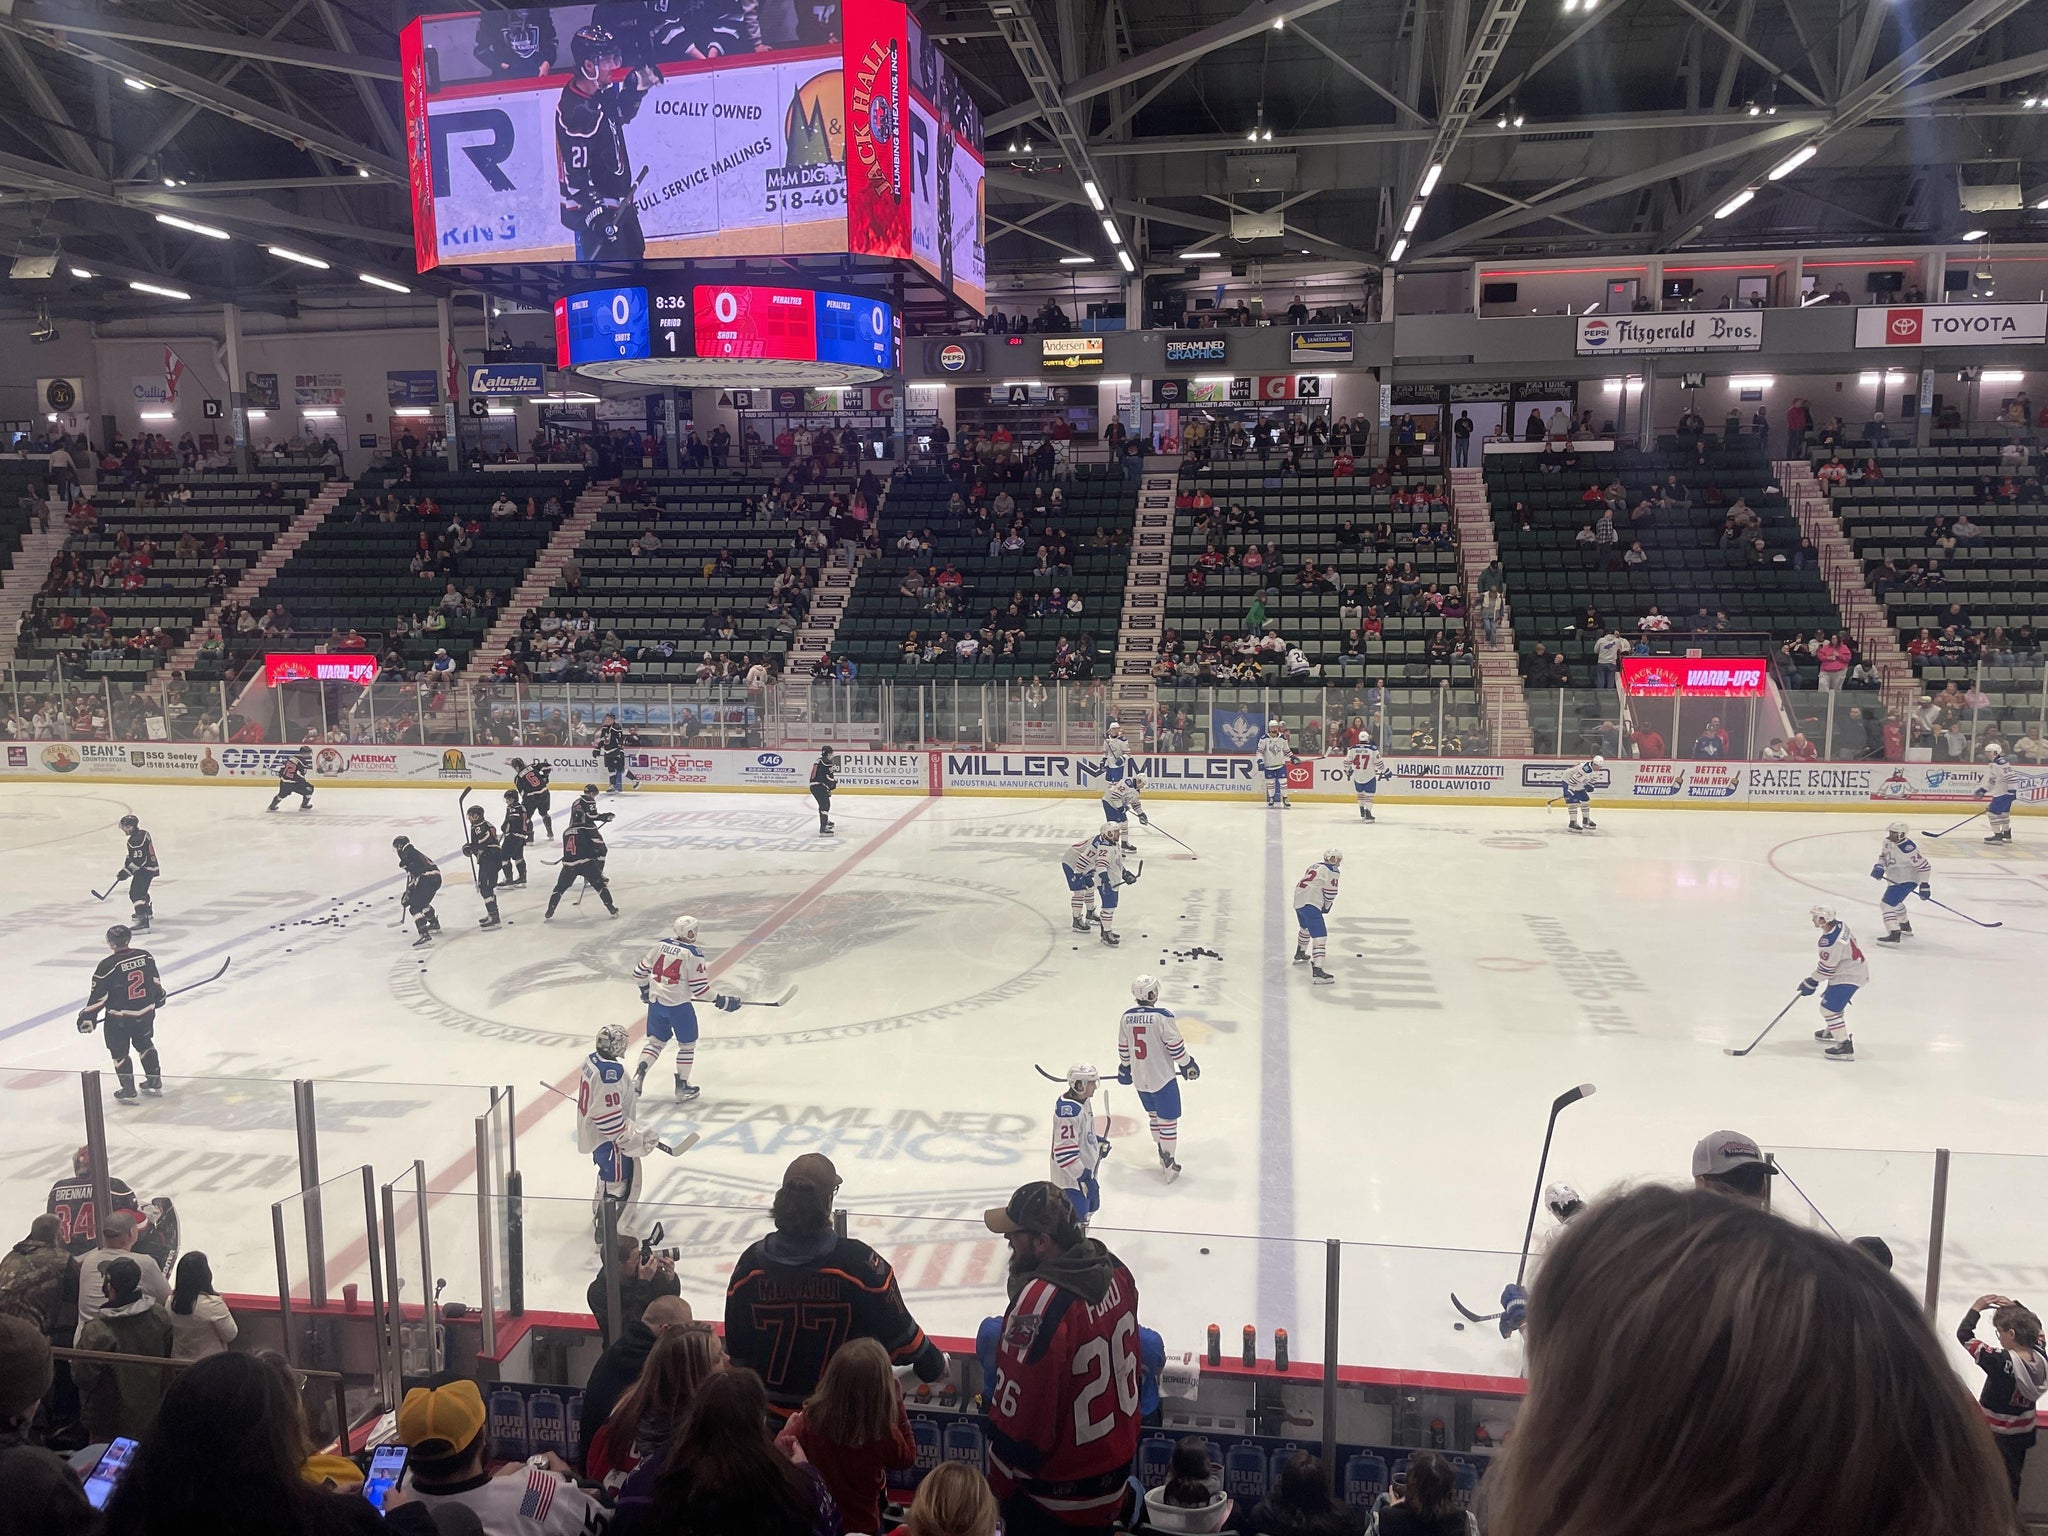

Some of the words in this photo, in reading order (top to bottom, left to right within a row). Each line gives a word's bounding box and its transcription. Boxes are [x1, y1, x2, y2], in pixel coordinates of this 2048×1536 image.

[890, 49, 898, 74] INC.
[852, 40, 892, 113] HALL
[891, 76, 900, 129] HEATING,
[655, 100, 709, 117] LOCALLY
[712, 103, 762, 120] OWNED
[828, 118, 842, 135] &
[892, 129, 900, 141] &
[427, 109, 518, 198] R
[571, 146, 588, 169] 21
[852, 123, 894, 198] JACK
[892, 140, 901, 195] PLUMBING
[632, 192, 661, 214] FULL
[662, 167, 710, 200] SERVICE
[711, 137, 772, 177] MAILINGS
[655, 296, 686, 309] 8:36
[772, 295, 803, 305] PENALTIES
[826, 300, 851, 311] PENALTIES
[612, 295, 630, 325] 0
[715, 292, 737, 323] 0
[659, 318, 682, 327] PERIOD
[871, 306, 884, 335] 0
[1931, 316, 2017, 333] TOYOTA
[614, 333, 631, 342] SHOTS
[717, 331, 737, 340] SHOTS
[1615, 318, 1696, 345] Fitzgerald
[1708, 317, 1757, 340] Bros.
[664, 331, 676, 352] 1
[724, 343, 732, 353] 0
[1043, 340, 1085, 352] Andersen
[1167, 341, 1225, 351] STREAMLINED
[619, 345, 626, 355] 0
[1167, 350, 1225, 360] GRAPHICS
[877, 354, 882, 364] 0
[471, 368, 538, 393] Galusha
[1686, 372, 1702, 385] W
[1266, 377, 1286, 398] G
[1302, 379, 1316, 394] X
[133, 385, 178, 403] Cullign
[737, 393, 749, 406] B
[1012, 387, 1025, 401] A
[206, 403, 217, 415] D
[472, 401, 484, 415] C
[317, 664, 373, 679] WARM-UPS
[1630, 666, 1652, 682] JACK
[1655, 668, 1679, 683] HALL
[1687, 670, 1761, 687] WARM-UPS
[82, 745, 126, 757] BEAN'S
[146, 751, 165, 760] SSG
[167, 752, 198, 762] Seeley
[351, 753, 397, 763] MEERKAT
[553, 758, 599, 767] COLLINS
[650, 754, 713, 768] Advance
[759, 755, 780, 764] JAG
[844, 755, 919, 766] PHINNEY
[949, 755, 1070, 776] MILLER
[1352, 754, 1370, 769] 47
[1127, 757, 1253, 779] MILLER
[1397, 764, 1440, 775] HARDING
[1455, 765, 1504, 776] MAZZOTTI
[1640, 764, 1671, 774] BETTER
[1695, 765, 1727, 775] BETTER
[526, 772, 539, 787] 6
[951, 779, 998, 787] INDUSTRIAL
[999, 780, 1069, 788] MANUFACTURING
[1634, 775, 1654, 783] THAN
[1656, 776, 1675, 784] NEW
[1689, 776, 1710, 785] THAN
[1711, 777, 1730, 785] NEW
[1749, 769, 1802, 788] BARE
[1807, 769, 1871, 788] BONES
[1945, 771, 1985, 782] Family
[1179, 783, 1252, 791] MANUFACTURING
[1410, 780, 1491, 790] 1800LAW1010
[1636, 786, 1672, 796] PAINTING
[1691, 787, 1727, 796] PAINTING
[565, 836, 577, 856] 4
[1910, 853, 1923, 863] 24
[661, 943, 682, 956] FULLER
[120, 958, 147, 972] BECKER
[652, 954, 683, 985] 44
[127, 970, 147, 1000] 2
[1125, 1014, 1154, 1024] GRAVELLE
[1133, 1026, 1148, 1060] 5
[604, 1092, 621, 1108] 90
[1060, 1125, 1076, 1139] 21
[55, 1186, 94, 1202] BRENNAN
[751, 1303, 852, 1385] 77
[1072, 1311, 1139, 1446] 26
[493, 1415, 524, 1428] BUD
[531, 1416, 561, 1430] BUD
[491, 1426, 526, 1440] LIGHT
[529, 1428, 565, 1441] LIGHT
[917, 1442, 938, 1457] UD
[948, 1444, 980, 1461] BUD
[1230, 1469, 1264, 1484] BUD
[1351, 1480, 1384, 1494] BUD
